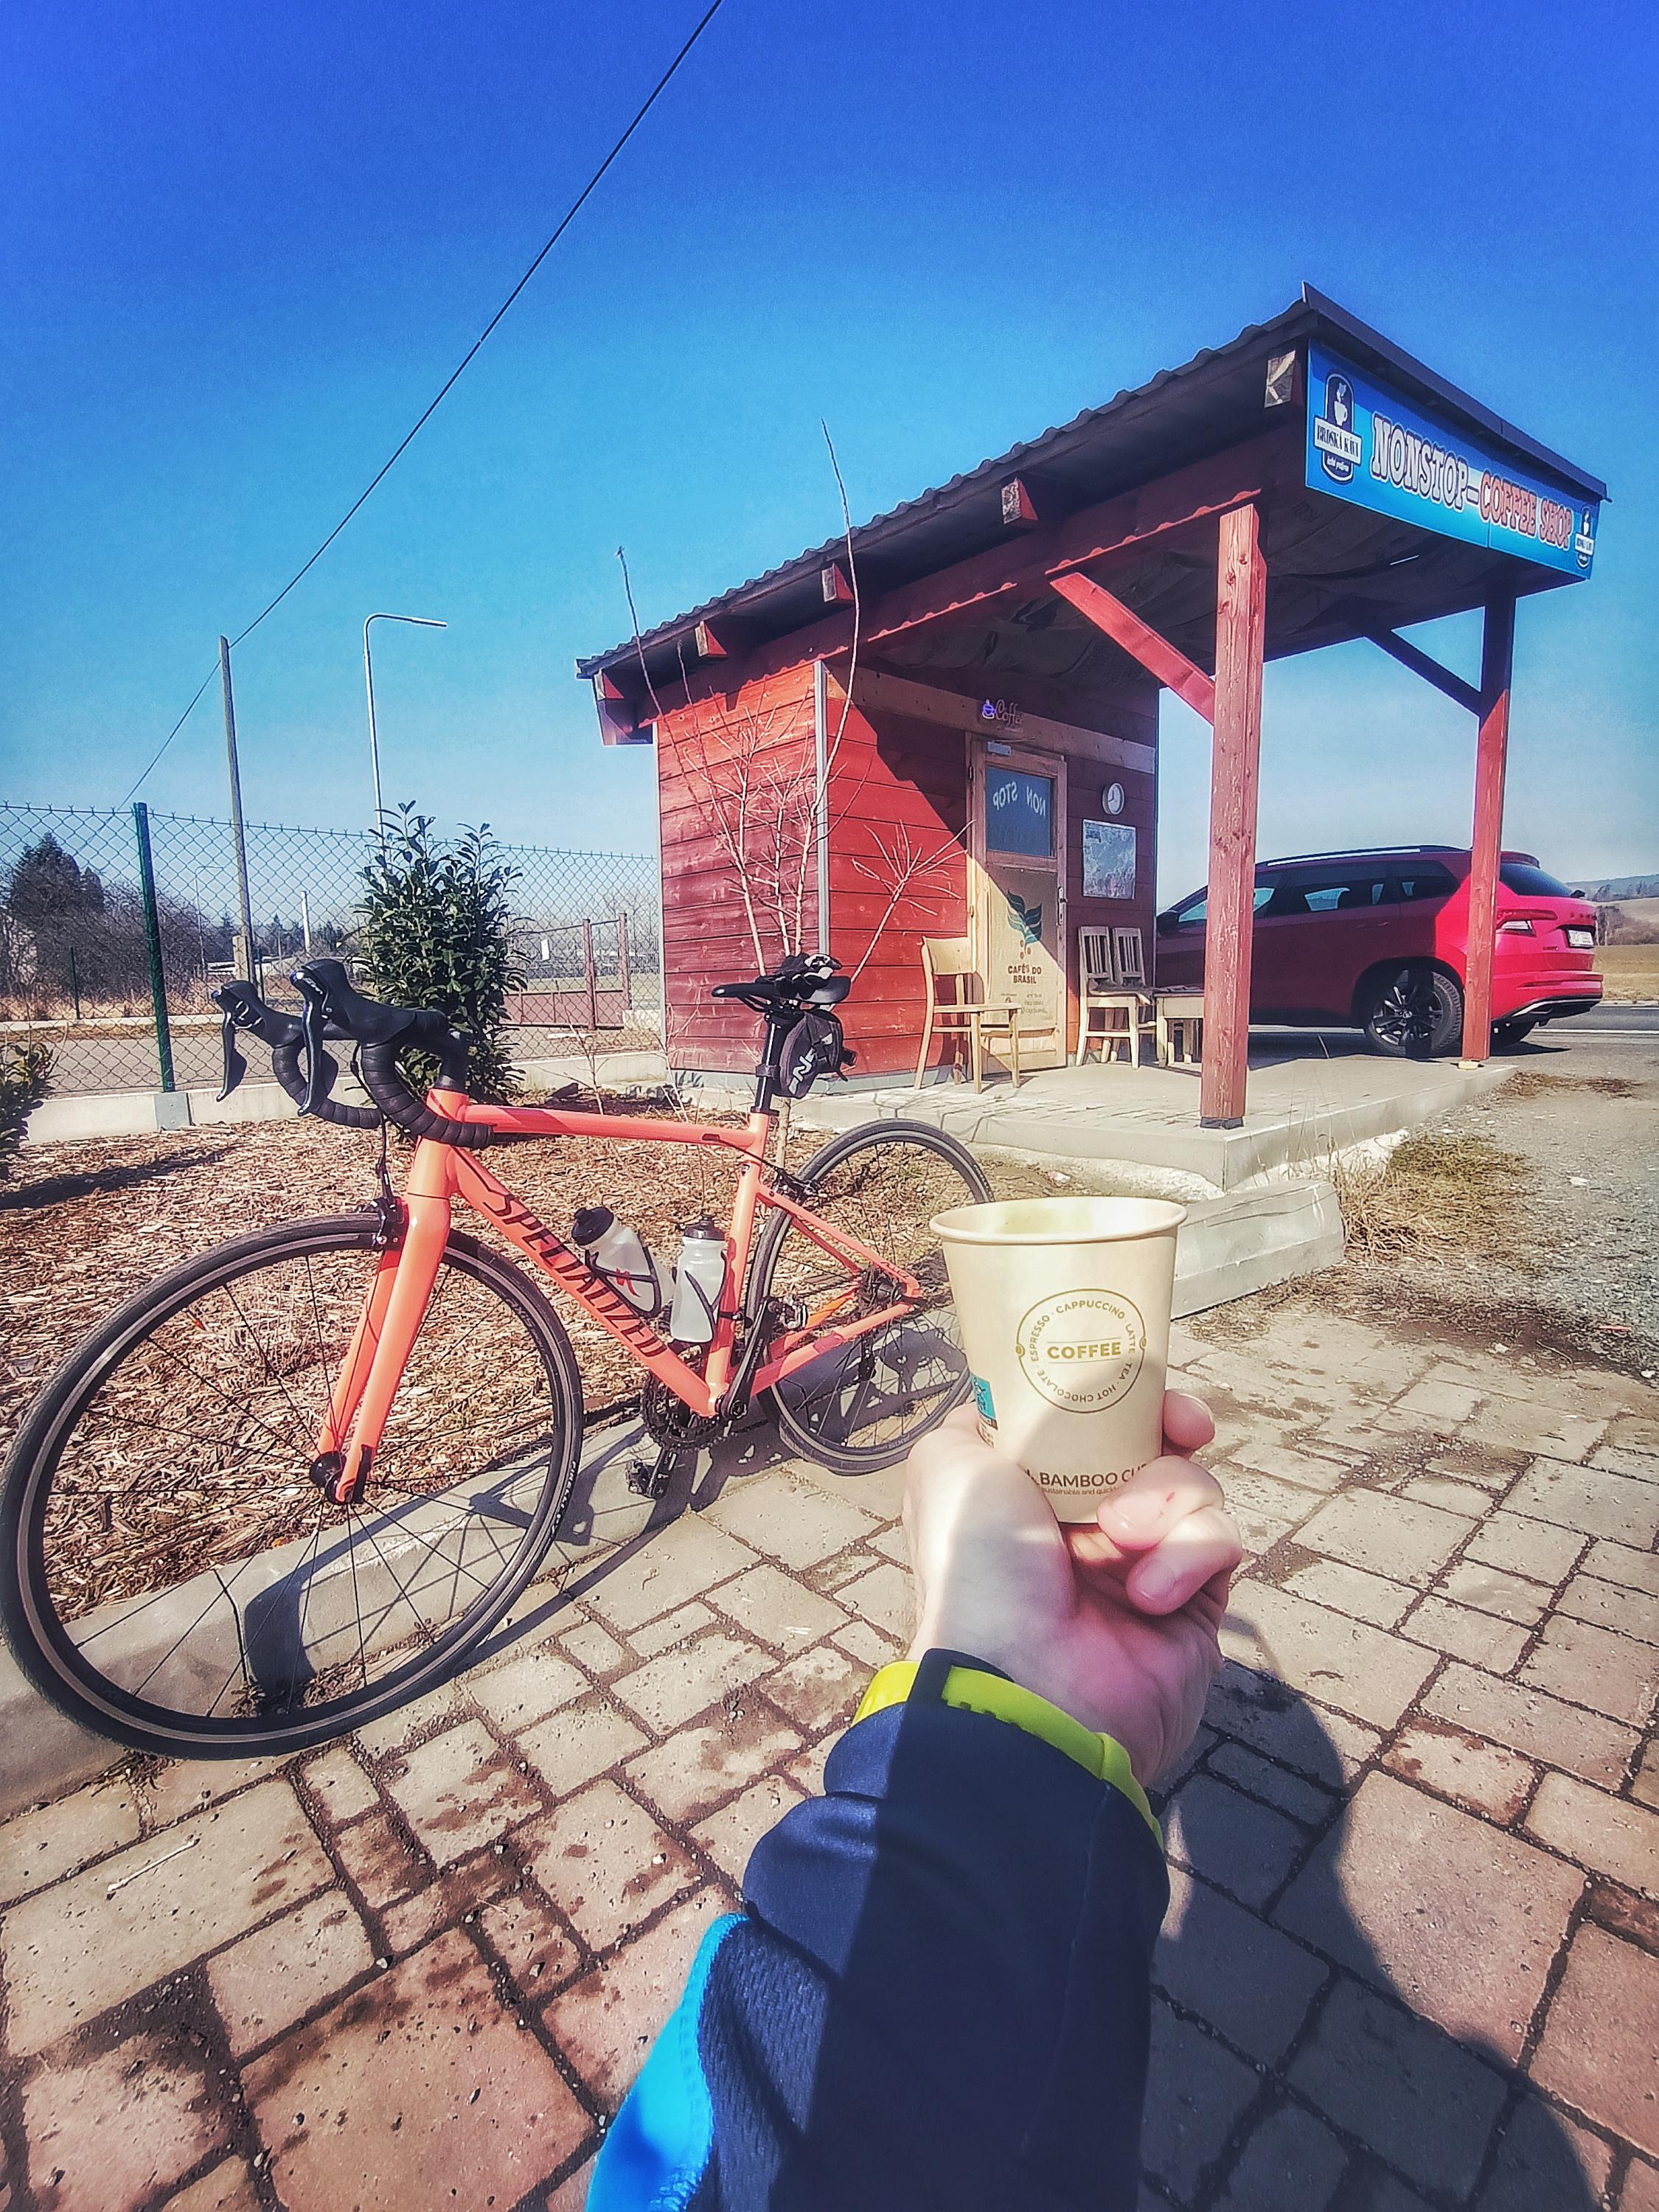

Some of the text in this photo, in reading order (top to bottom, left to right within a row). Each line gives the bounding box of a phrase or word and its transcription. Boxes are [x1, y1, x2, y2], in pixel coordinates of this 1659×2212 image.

[1540, 498, 1573, 549] SHOP
[1008, 964, 1042, 975] CAFÉS DO
[1013, 975, 1037, 984] BRASIL
[482, 1189, 667, 1357] SPECIALIZED
[1029, 1300, 1135, 1402] ESPRESSO CAPPUCCINO LATTE TEA HOT CHOCOLATE
[1047, 1342, 1121, 1359] COFFEE
[1040, 1472, 1118, 1488] BAMBOO
